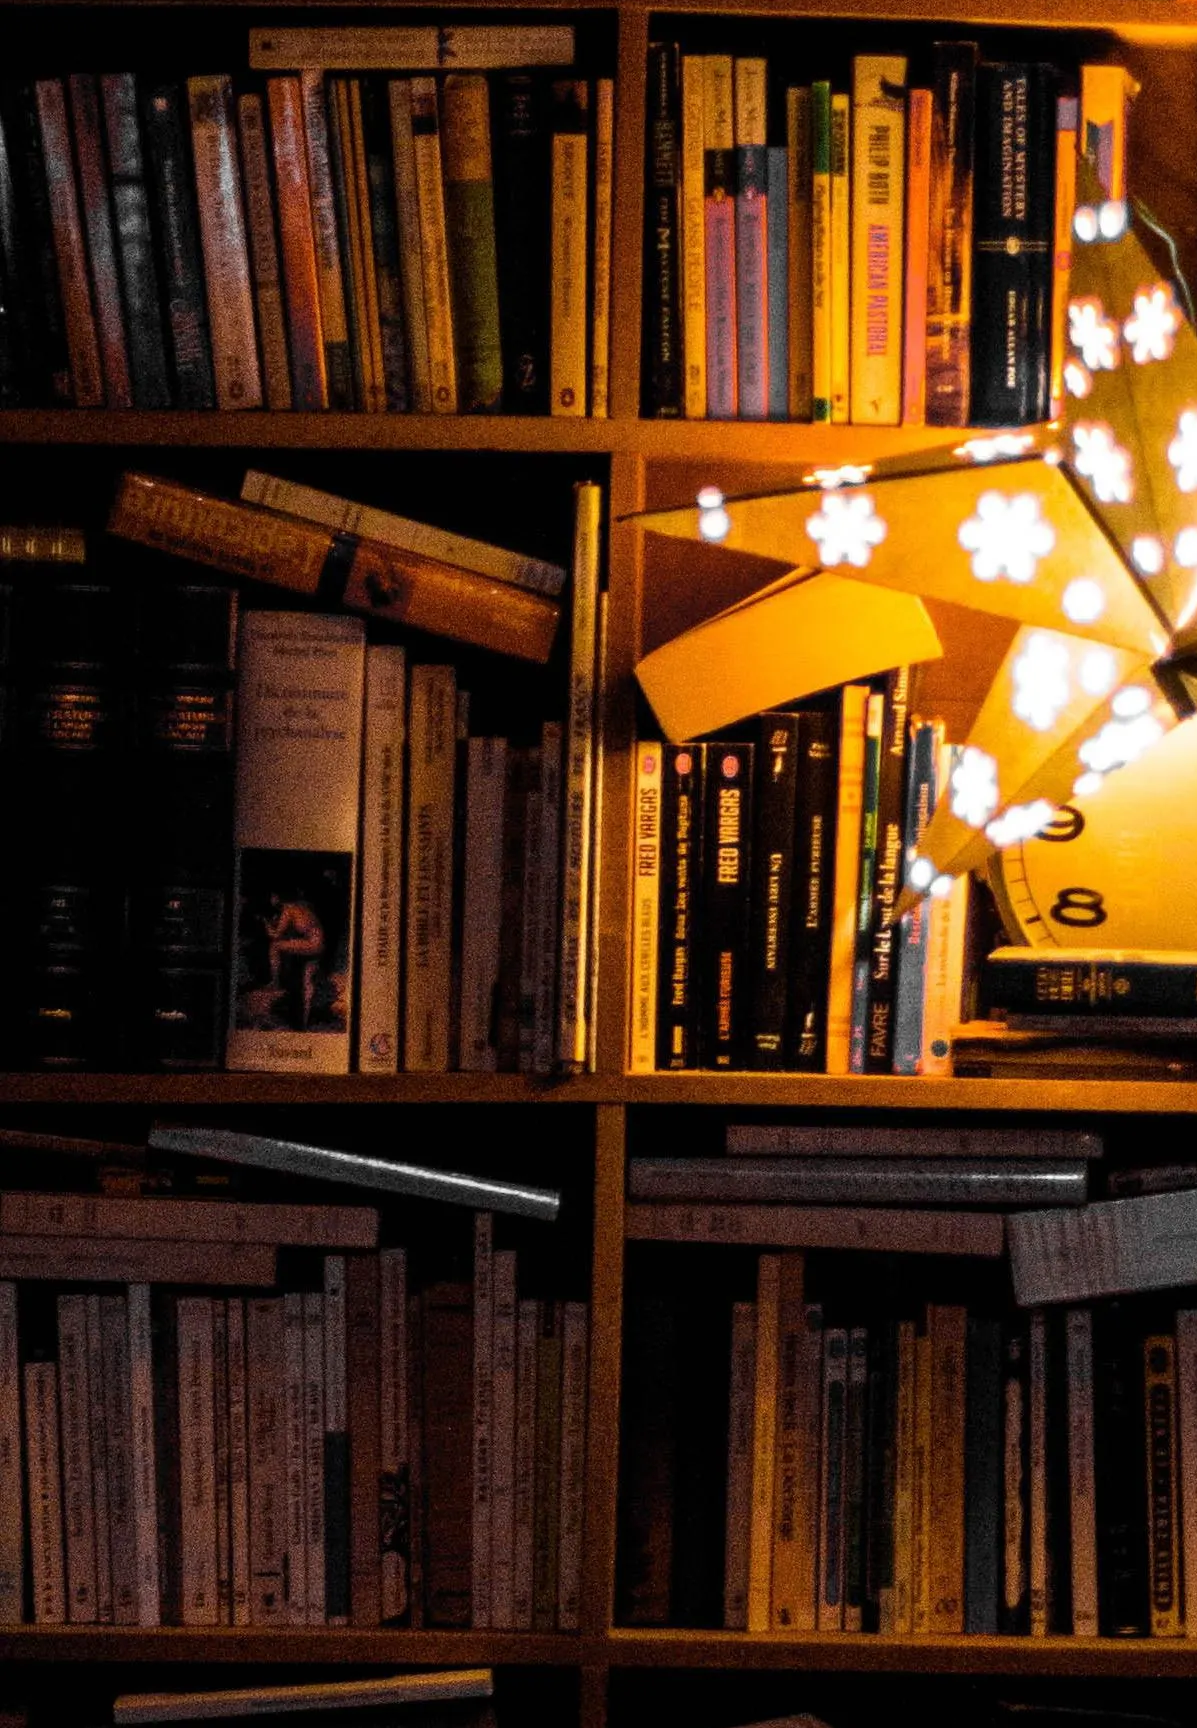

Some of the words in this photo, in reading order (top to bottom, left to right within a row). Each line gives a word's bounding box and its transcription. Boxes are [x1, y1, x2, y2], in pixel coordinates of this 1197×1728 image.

[1001, 79, 1014, 111] AND
[1014, 77, 1027, 124] TALES
[868, 125, 890, 165] PHILIP
[1014, 126, 1026, 146] OF
[1001, 115, 1013, 218] IMAGINATION
[1013, 151, 1027, 221] MYSTERY
[868, 173, 889, 205] ROTH
[867, 224, 889, 289] AMERICAN
[866, 294, 889, 357] PASTORAL
[1005, 289, 1018, 326] EDGAR
[1005, 329, 1017, 363] ALLAN
[1005, 365, 1017, 388] POE
[889, 704, 907, 757] Arnaud
[638, 787, 658, 842] VARGAS
[718, 788, 742, 844] VARGAS
[1030, 804, 1086, 843] 9
[638, 844, 658, 877] FRED
[809, 815, 822, 873] FURIEUSE
[878, 823, 901, 870] langue
[717, 847, 741, 884] FRED
[878, 871, 896, 886] la
[806, 876, 821, 929] L'ARMÉE
[877, 886, 895, 904] de
[1050, 887, 1108, 928] 8
[640, 931, 651, 970] CERCLES
[874, 955, 889, 980] Sur
[640, 972, 650, 994] AUX
[718, 951, 733, 994] FURIEUSE
[638, 995, 651, 1040] L'HOMME
[716, 995, 732, 1042] L'ARMÉE
[869, 1001, 889, 1057] FAVRE
